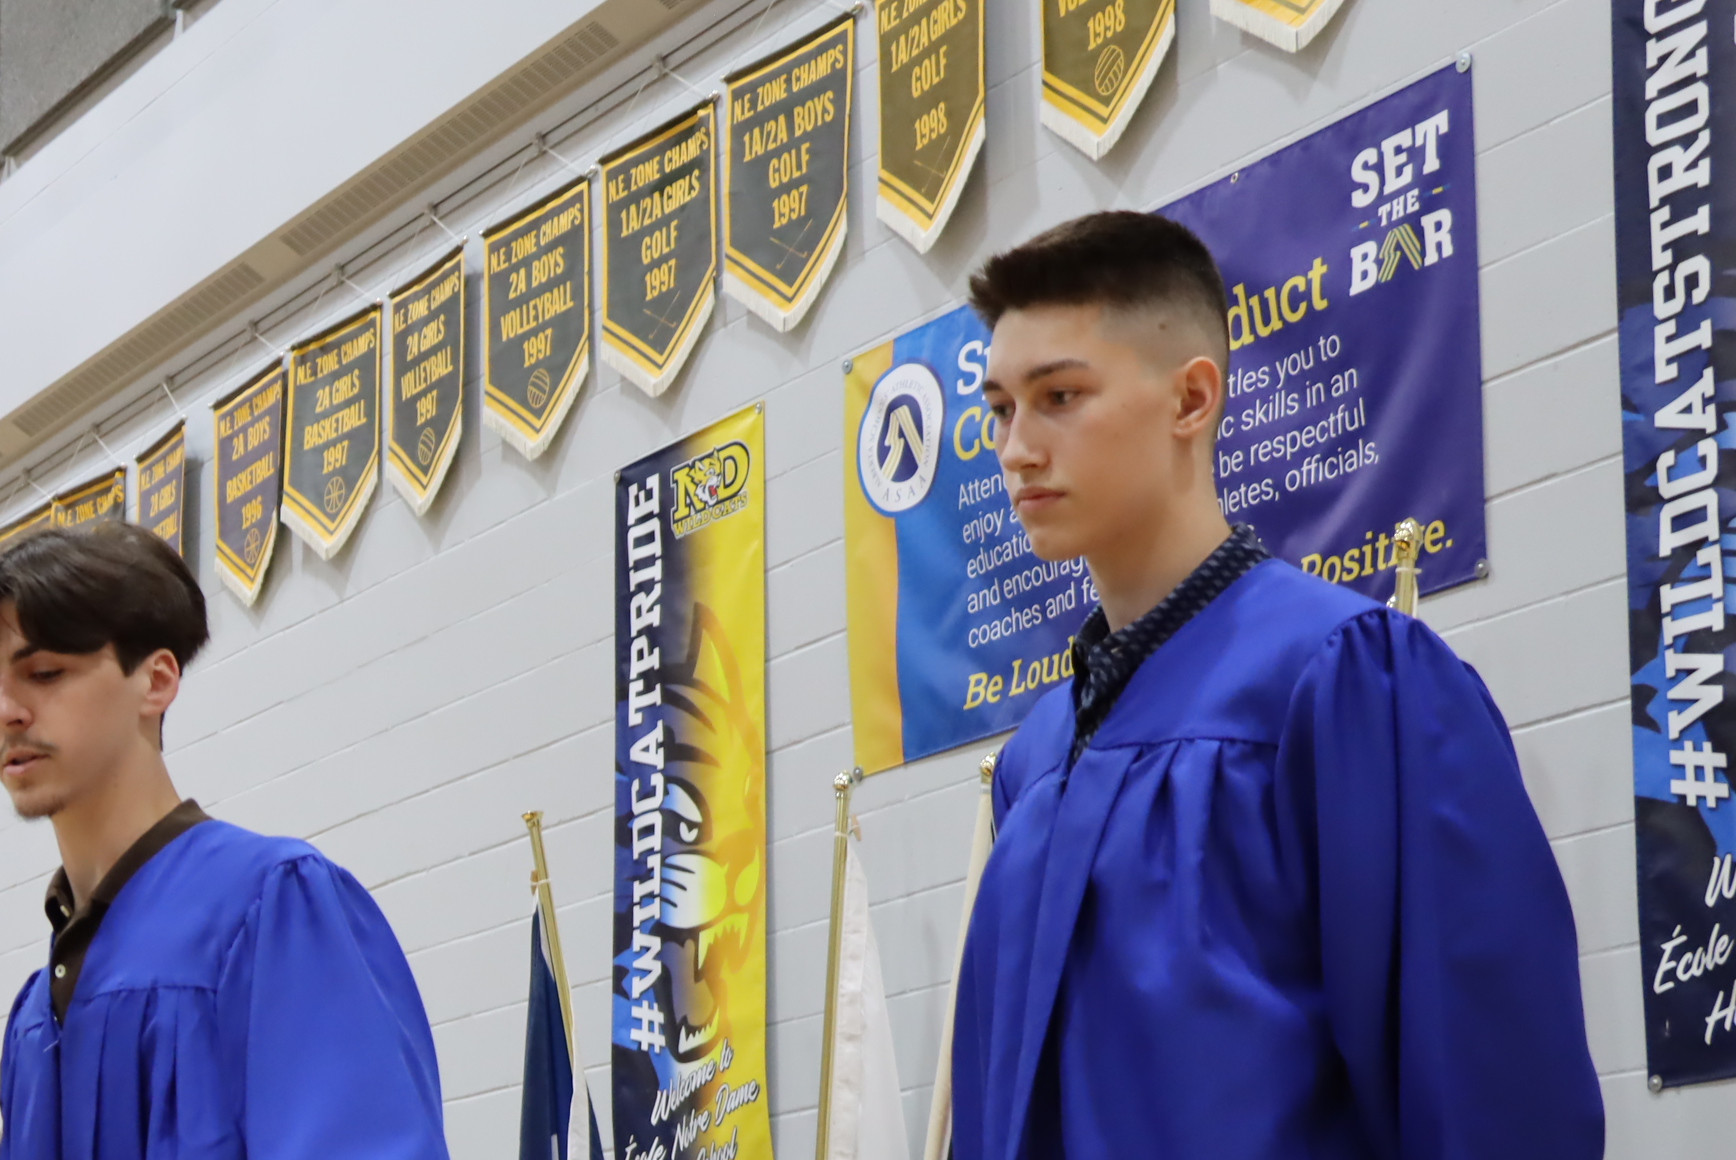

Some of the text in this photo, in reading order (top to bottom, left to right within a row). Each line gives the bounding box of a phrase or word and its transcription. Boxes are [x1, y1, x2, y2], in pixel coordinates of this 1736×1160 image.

[891, 0, 966, 73] 1A/2A GIRLS
[1087, 4, 1126, 51] 1998
[734, 44, 844, 124] N.E. ZONE CHAMPS
[911, 44, 947, 98] GOLF
[743, 90, 835, 162] 1A/2A BOYS
[914, 101, 947, 151] 1998
[630, 156, 660, 191] ZONE
[665, 127, 708, 173] CHAMPS
[768, 142, 810, 188] GOLF
[1351, 109, 1449, 208] SET
[620, 169, 700, 237] 1A/2A GIRLS
[772, 184, 808, 229] 1997
[1378, 188, 1420, 227] THE
[511, 230, 537, 263] ZONE
[540, 203, 581, 246] CHAMPS
[641, 219, 678, 265] GOLF
[1349, 208, 1453, 297] BAR
[407, 294, 429, 325] ZONE
[431, 271, 459, 310] CHAMPS
[508, 246, 564, 300] 2A BOYS
[645, 258, 676, 301] 1997
[501, 281, 574, 342] VOLLEYBALL
[1228, 256, 1329, 350] duct
[316, 349, 339, 379] ZONE
[341, 328, 376, 365] CHAMPS
[407, 313, 445, 361] 2A GIRLS
[523, 328, 552, 368] 1997
[1276, 346, 1314, 389] you
[1318, 334, 1340, 362] to
[315, 368, 360, 413] 2A GIRLS
[401, 345, 453, 401] VOLLEYBALL
[1240, 390, 1299, 431] skills
[1306, 381, 1325, 408] in
[1331, 367, 1358, 398] an
[234, 402, 252, 431] ZONE
[253, 380, 282, 416] CHAMPS
[303, 399, 367, 450] BASKETBALL
[416, 389, 438, 426] 1997
[232, 415, 271, 462] 2A BOYS
[322, 440, 350, 475] 1997
[1219, 448, 1244, 478] be
[1250, 397, 1366, 466] respectful
[226, 451, 275, 504] BASKETBALL
[76, 500, 96, 524] ZONE
[242, 495, 263, 530] 1996
[672, 490, 748, 538] WILDCATS
[963, 507, 1005, 544] enjoy
[967, 577, 1001, 614] and
[1284, 438, 1379, 492] officials,
[968, 604, 1042, 648] coaches
[1045, 581, 1076, 619] and
[963, 672, 1003, 710] Be
[627, 472, 665, 1056] #WILDCATPRIDE
[651, 1038, 734, 1126] Welcome to
[715, 1079, 760, 1126] Dame
